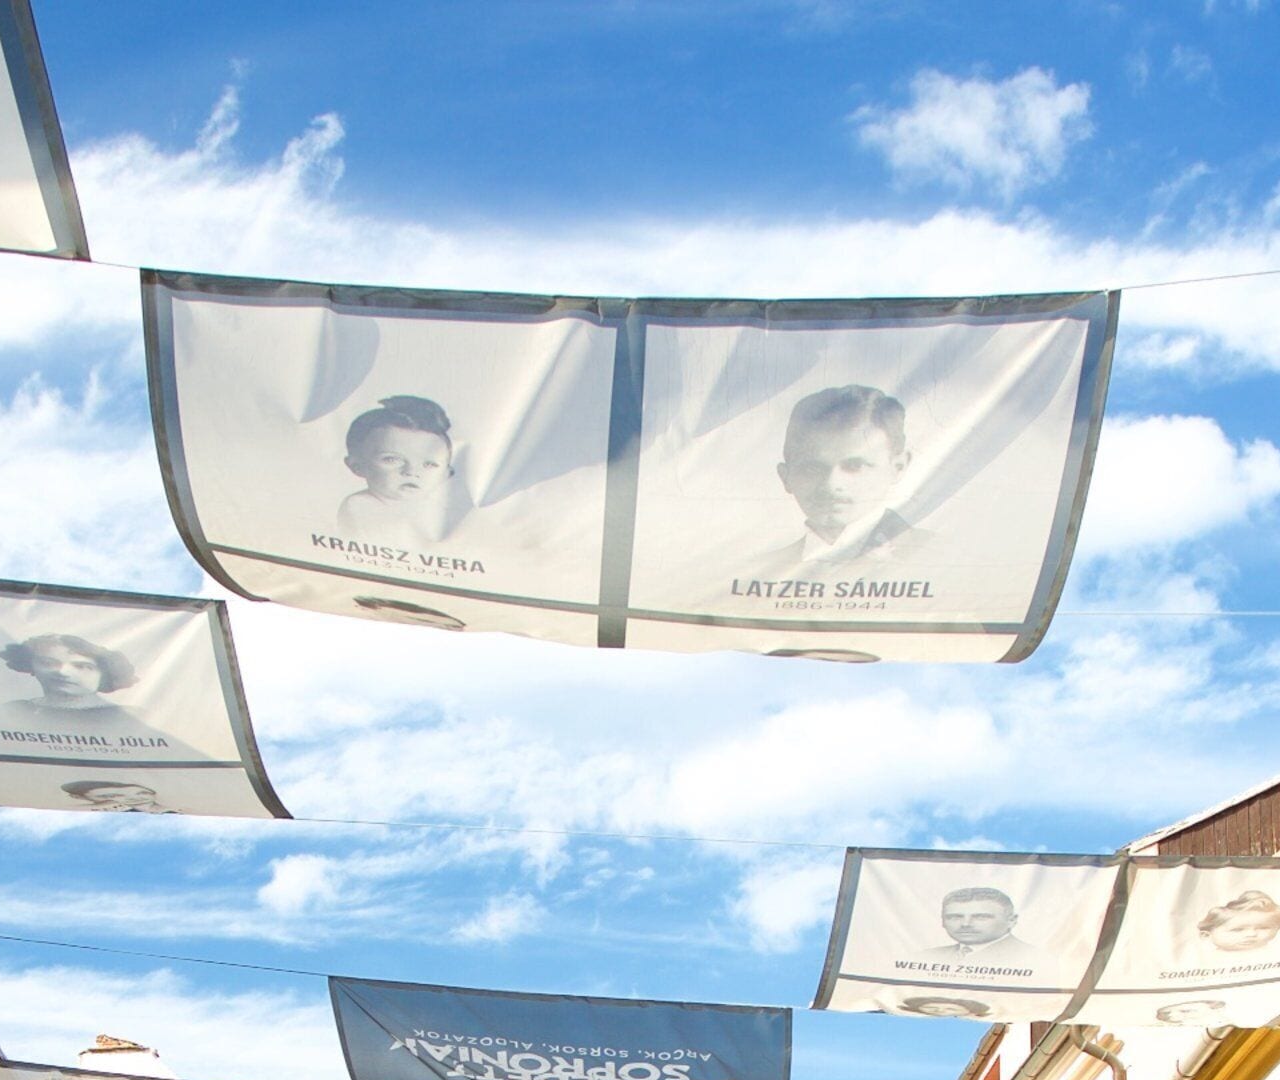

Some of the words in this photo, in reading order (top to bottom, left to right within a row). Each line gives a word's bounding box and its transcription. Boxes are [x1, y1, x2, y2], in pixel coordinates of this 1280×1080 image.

[311, 533, 411, 564] KRAUSZ
[419, 553, 486, 574] VERA
[731, 578, 825, 599] LATZER
[834, 577, 935, 599] SÁMUEL
[773, 600, 887, 611] 1886-1944
[0, 729, 114, 748] ROSENTHAL
[119, 734, 170, 749] JÚLIA
[894, 959, 951, 973] WEILER
[955, 964, 1034, 978] ZSIGMOND
[1158, 967, 1226, 980] SOMOGYI
